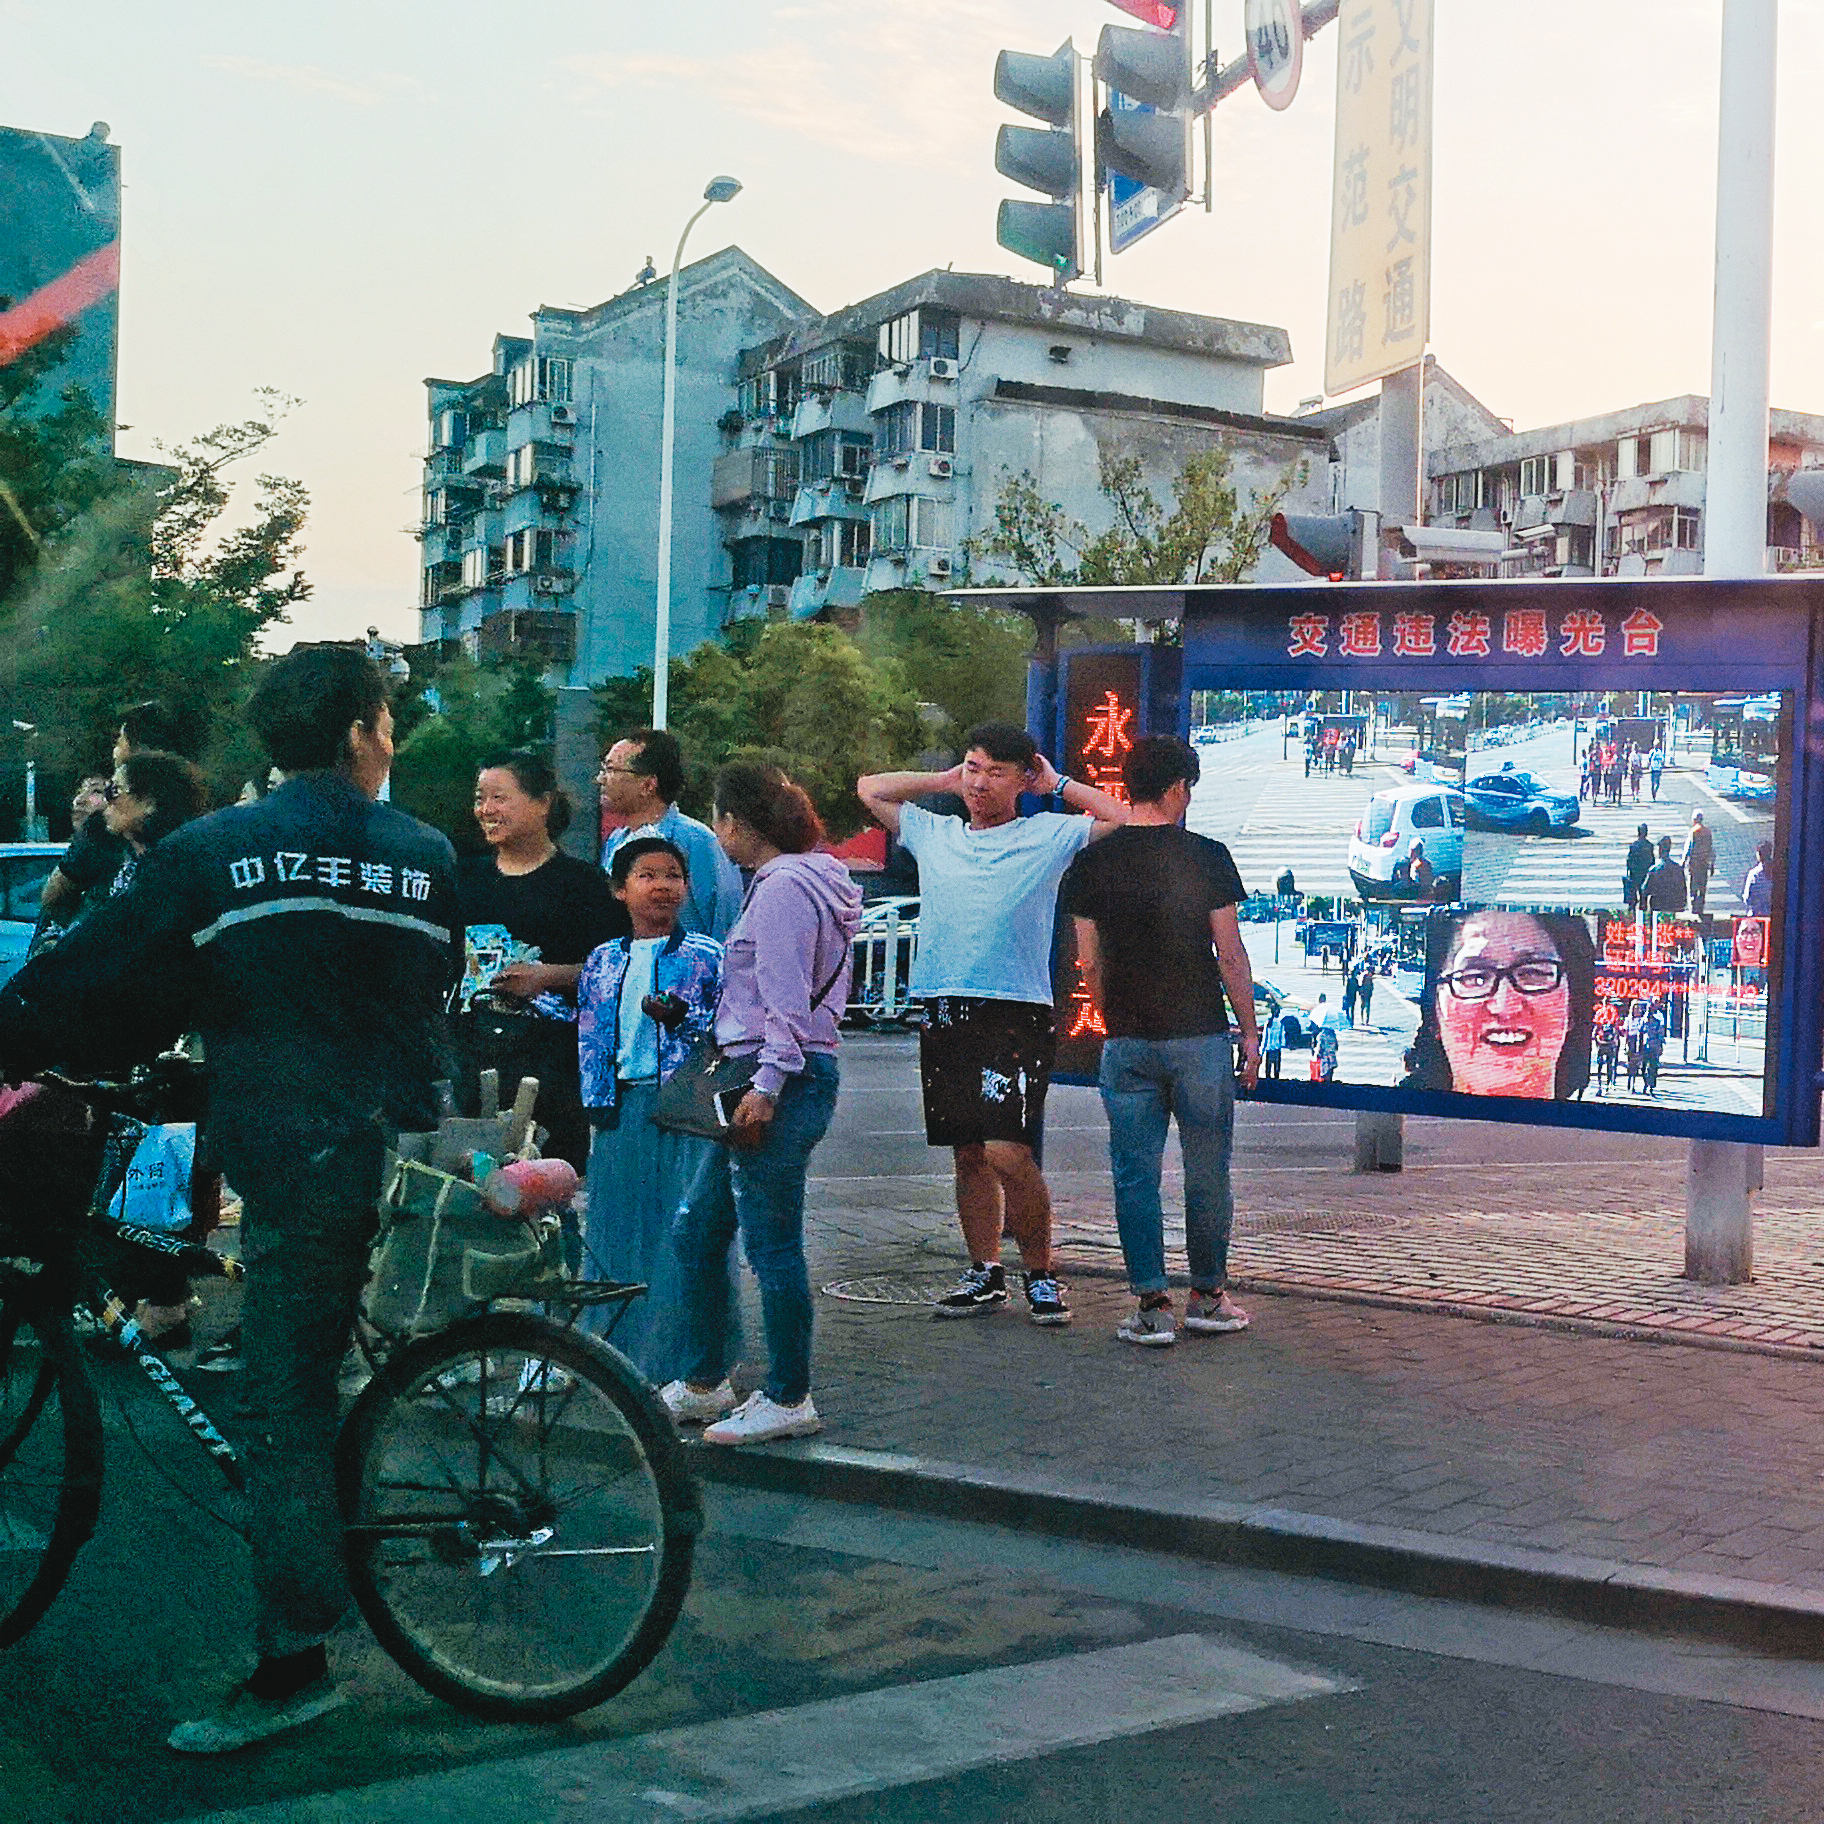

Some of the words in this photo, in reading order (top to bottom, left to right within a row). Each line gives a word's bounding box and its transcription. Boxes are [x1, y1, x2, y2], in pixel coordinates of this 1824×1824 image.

[1335, 6, 1376, 368] 示范路
[1286, 606, 1665, 658] 交通违法曝光台
[139, 1355, 237, 1461] GIANT
